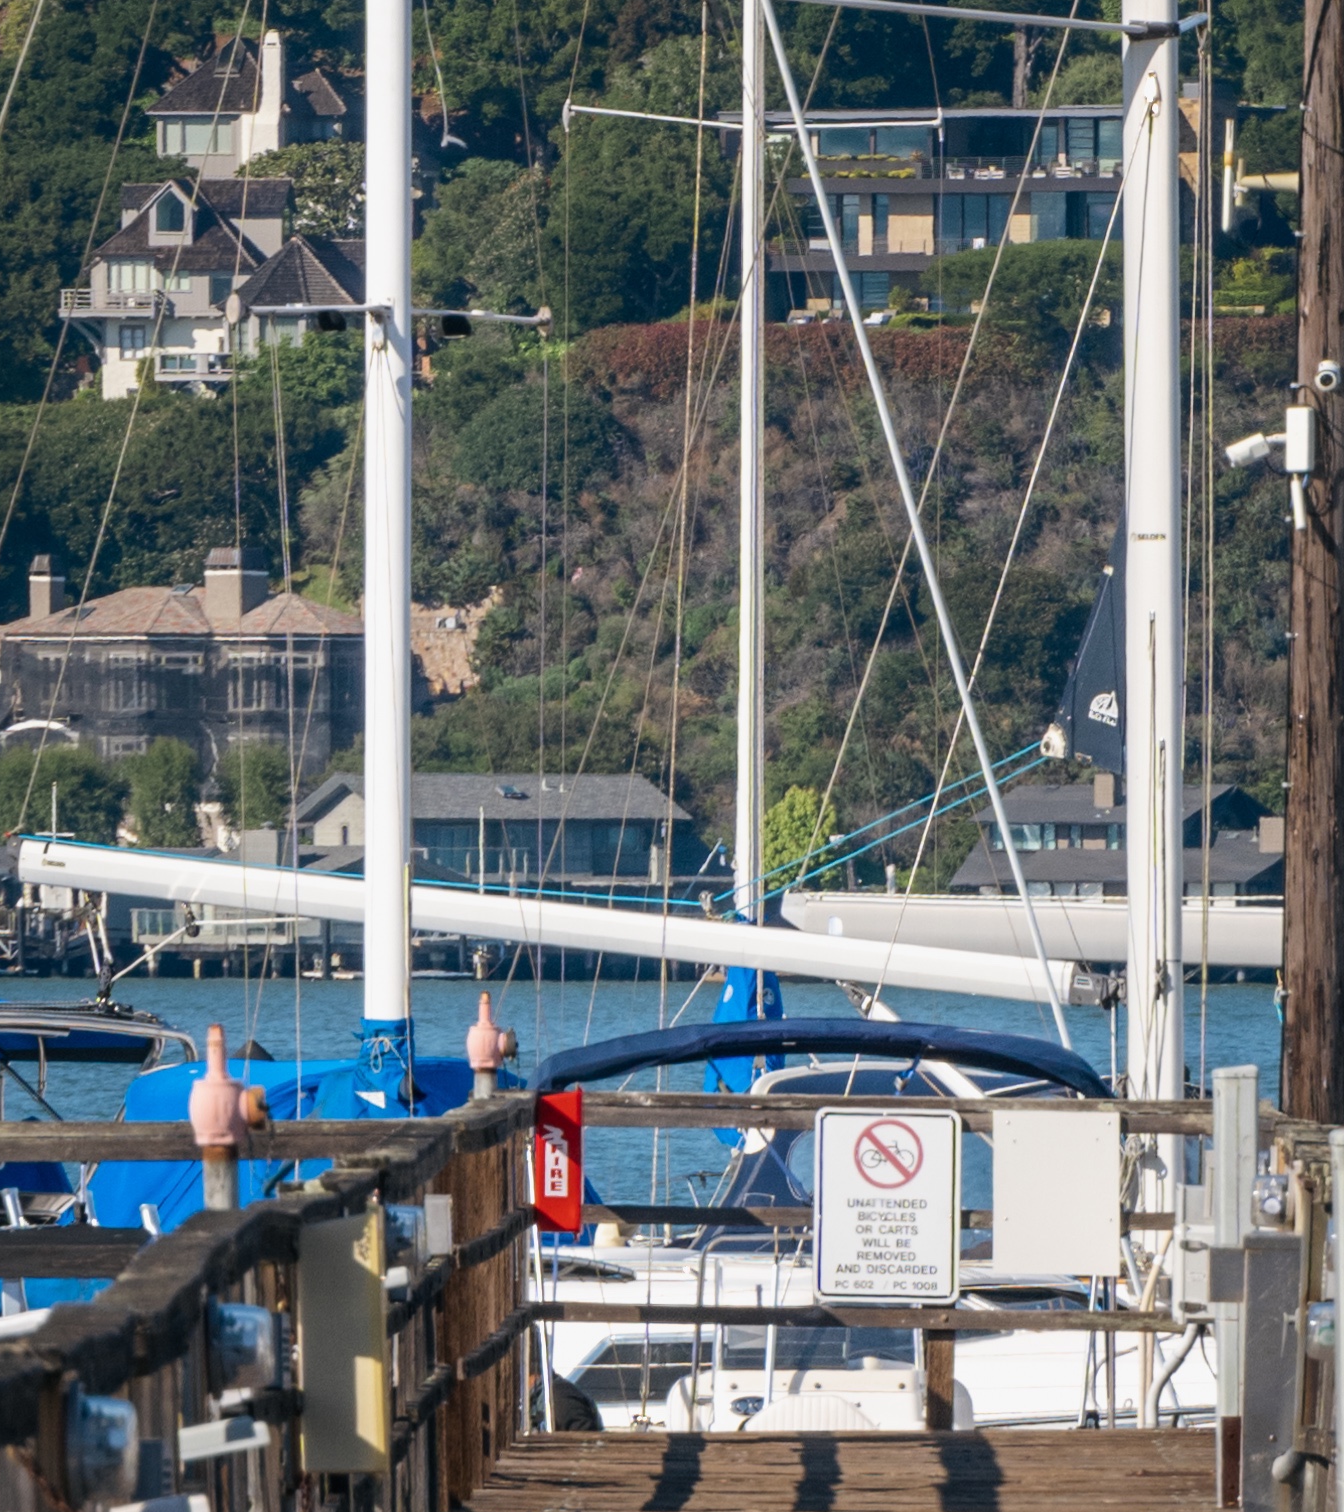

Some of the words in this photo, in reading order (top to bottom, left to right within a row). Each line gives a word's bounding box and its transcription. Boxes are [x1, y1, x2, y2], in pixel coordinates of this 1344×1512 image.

[550, 1143, 564, 1192] FIRE
[847, 1198, 928, 1209] UNATTENDED
[857, 1211, 916, 1222] BICYCLES
[855, 1224, 873, 1234] OR
[878, 1225, 918, 1236] CARTS
[861, 1237, 890, 1248] WILL
[896, 1238, 911, 1248] BE
[856, 1251, 916, 1261] REMOVED
[836, 1263, 861, 1274] AND
[866, 1264, 938, 1275] DISCARDED
[834, 1280, 849, 1289] PC
[853, 1280, 874, 1289] 602
[893, 1281, 907, 1290] PC
[912, 1281, 938, 1291] 1008
